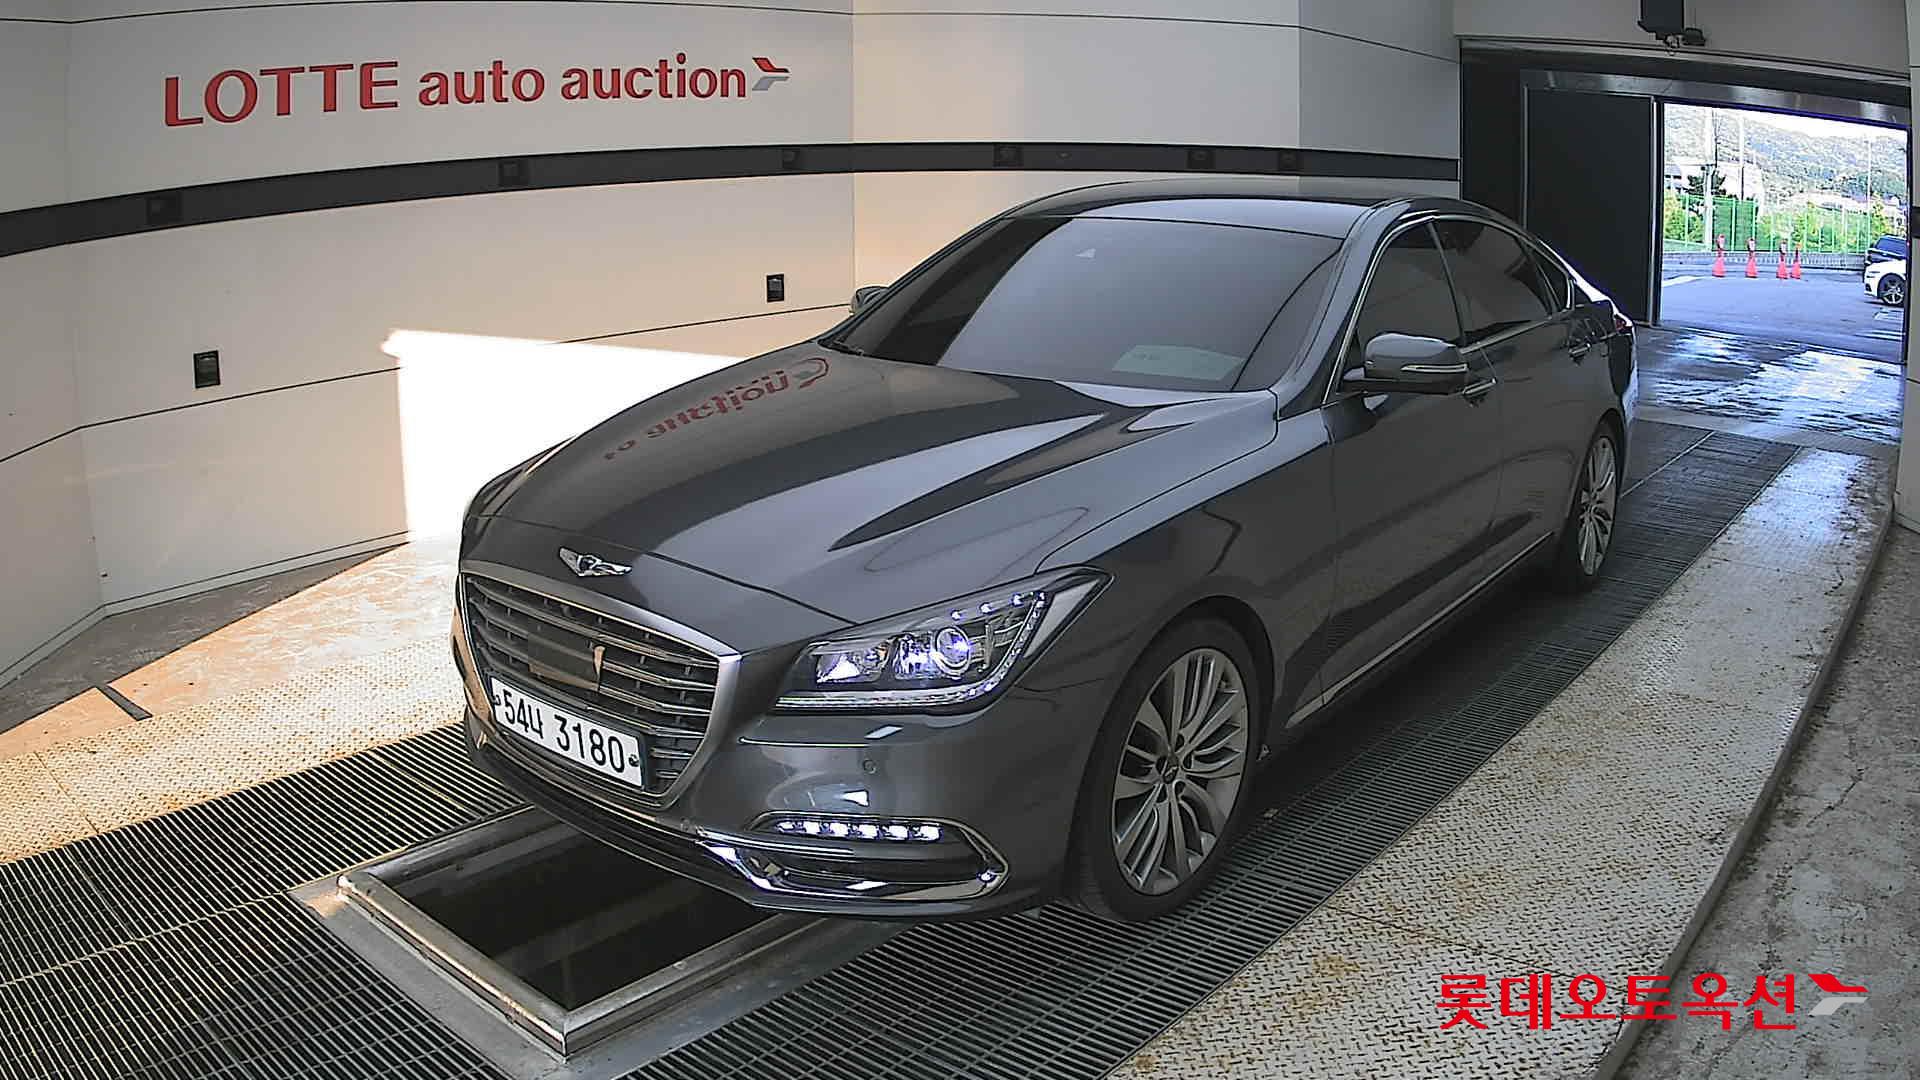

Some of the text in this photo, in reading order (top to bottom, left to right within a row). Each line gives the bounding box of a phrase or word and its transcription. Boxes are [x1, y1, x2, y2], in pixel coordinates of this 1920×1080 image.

[164, 52, 747, 127] LOTTE auto auction
[502, 688, 626, 774] 54나 3180
